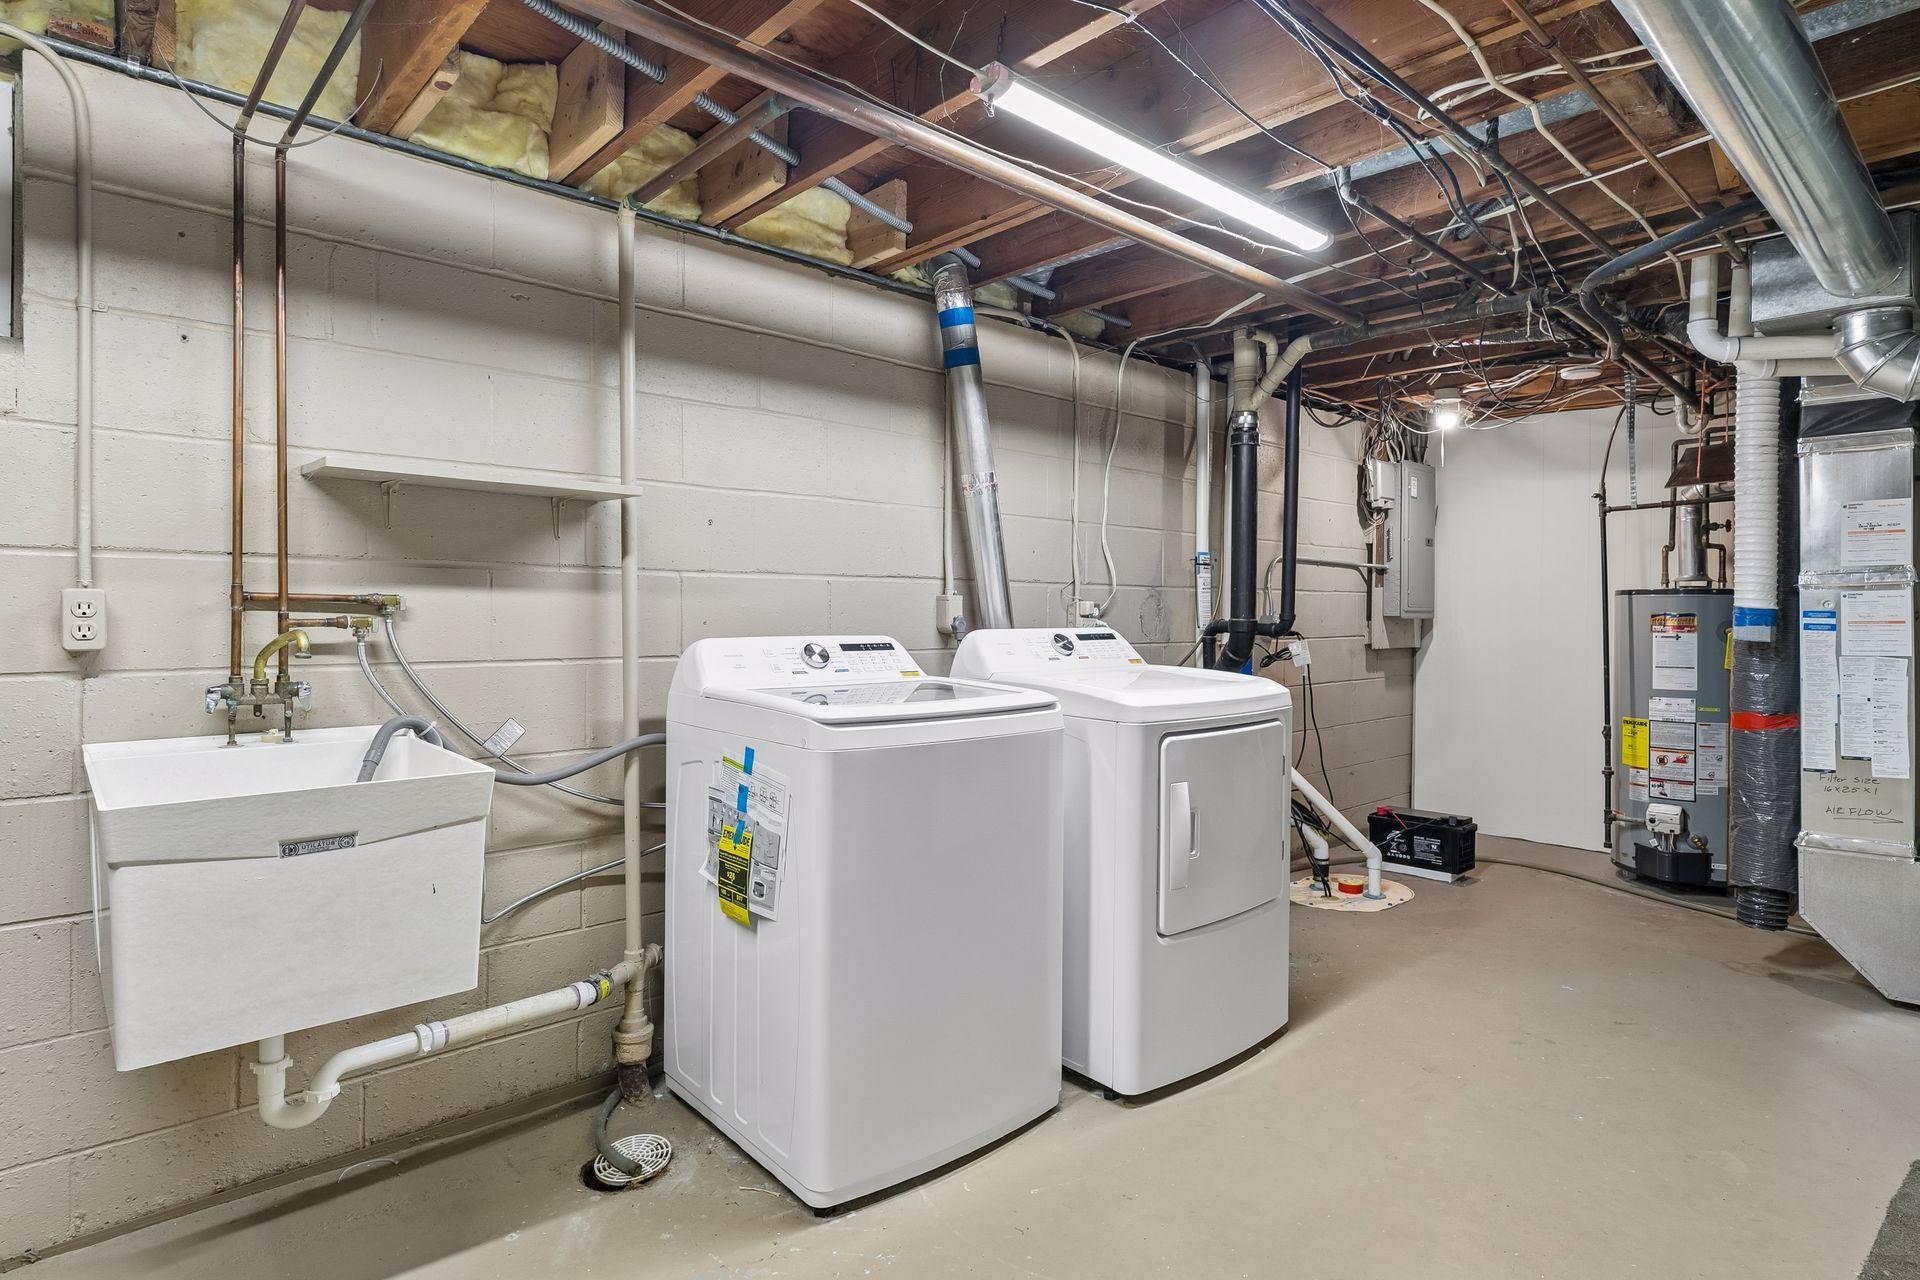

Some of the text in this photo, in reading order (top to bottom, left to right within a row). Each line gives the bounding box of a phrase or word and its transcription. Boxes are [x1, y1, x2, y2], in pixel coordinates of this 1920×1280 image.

[1819, 773, 1847, 782] Filter
[1825, 805, 1892, 816] AIR FLOW
